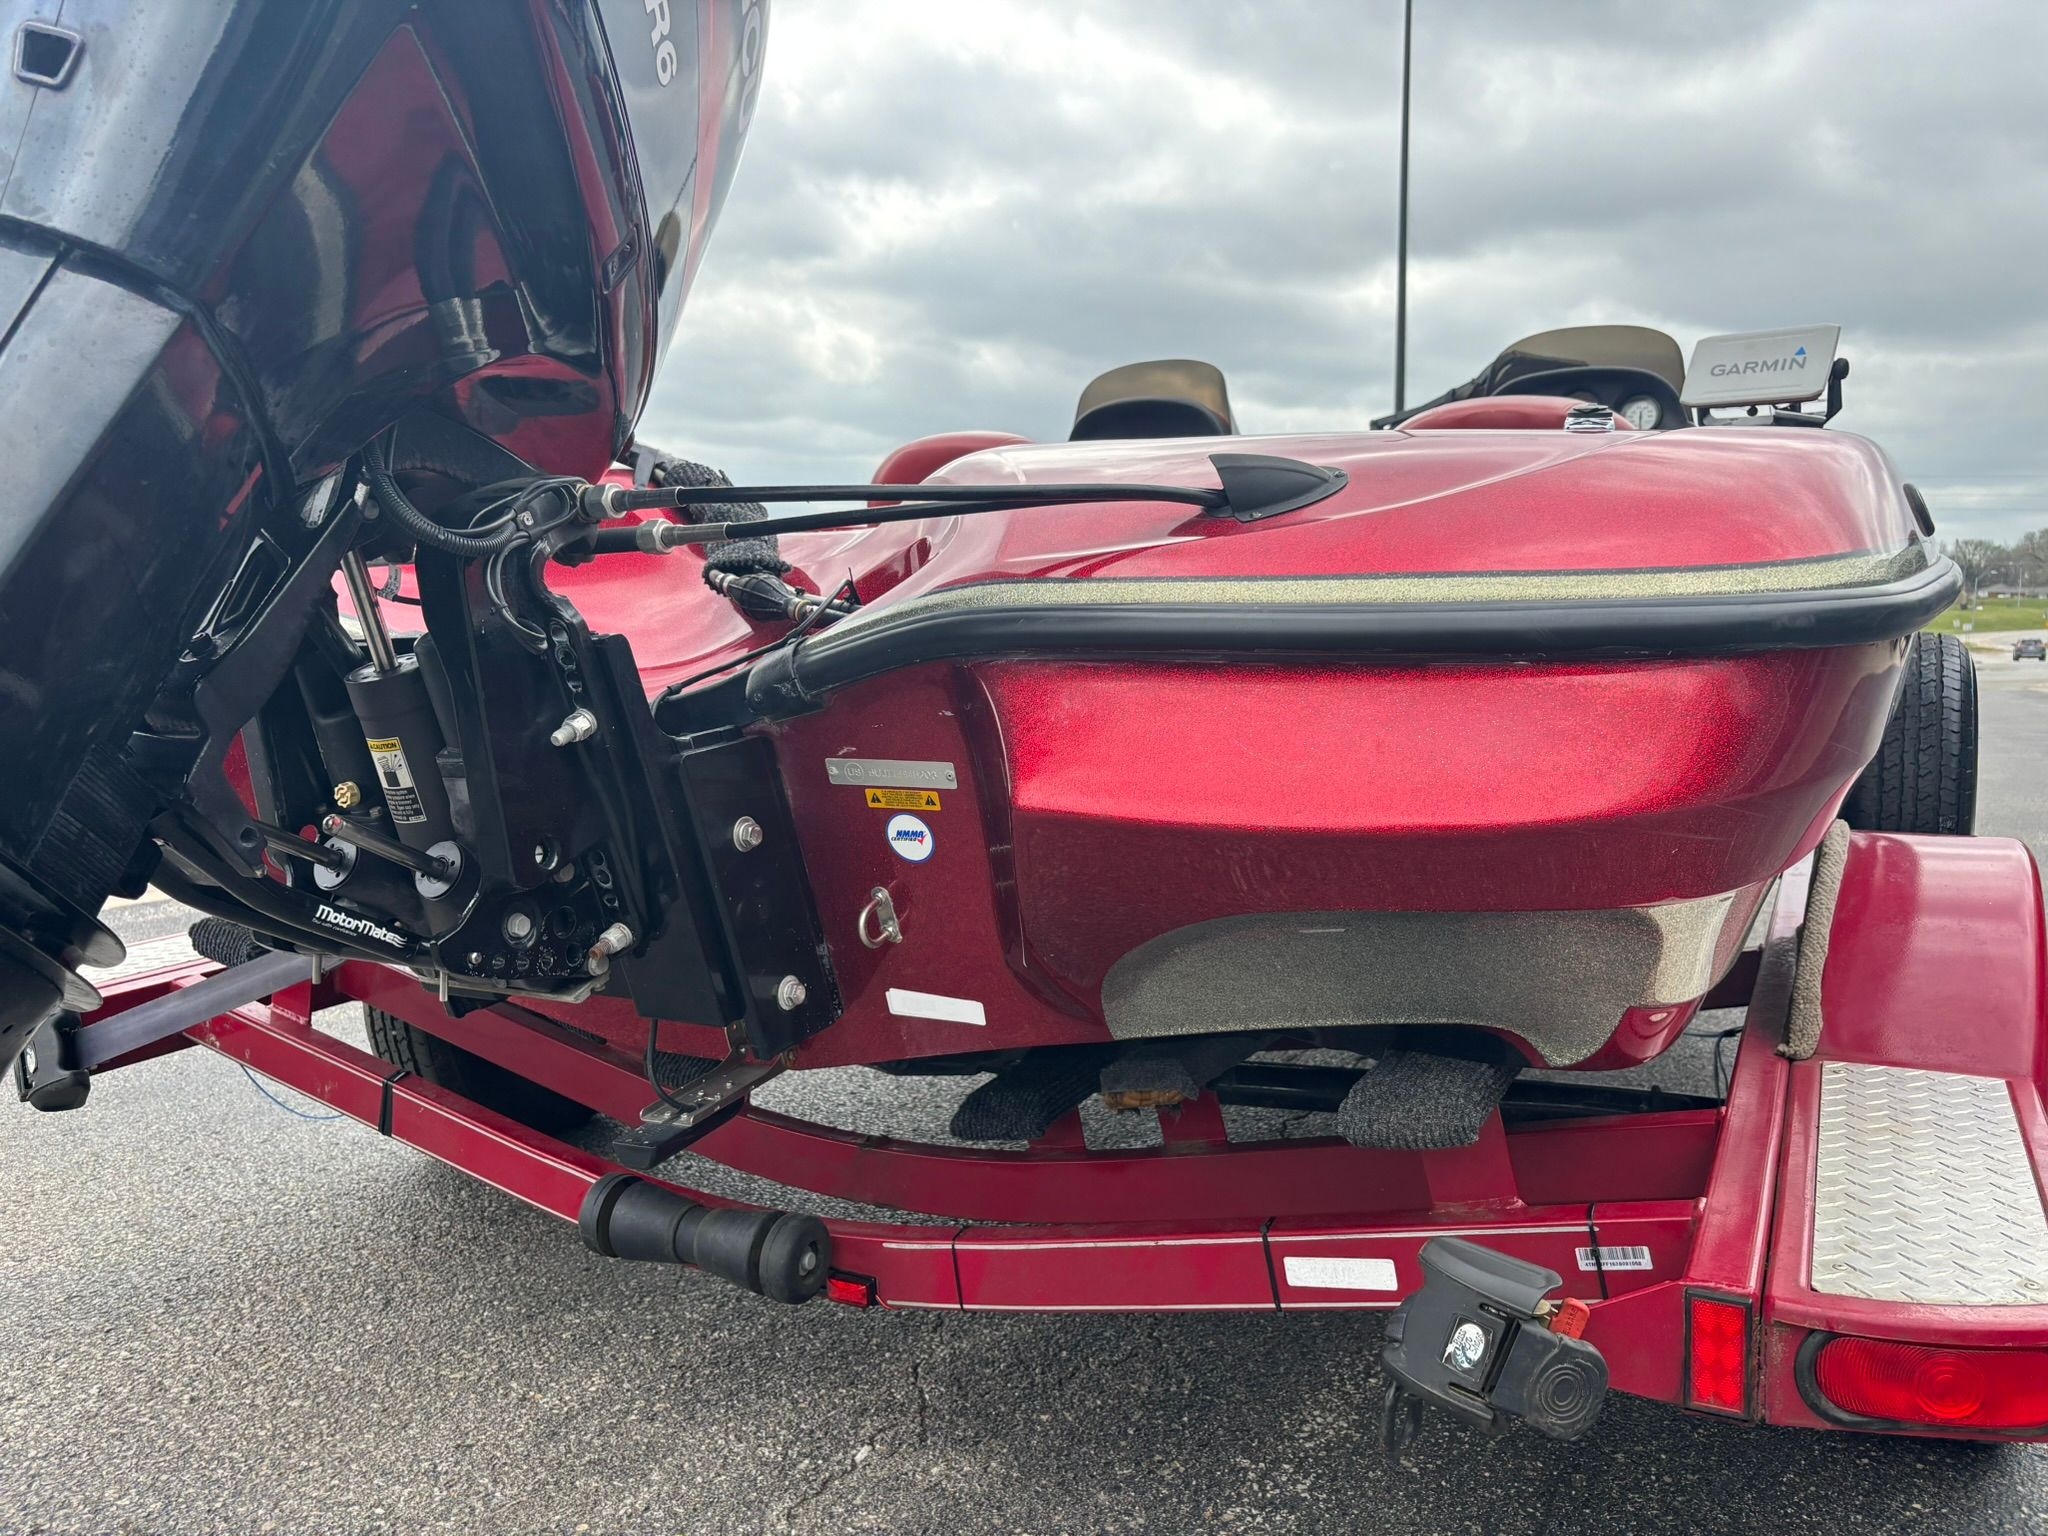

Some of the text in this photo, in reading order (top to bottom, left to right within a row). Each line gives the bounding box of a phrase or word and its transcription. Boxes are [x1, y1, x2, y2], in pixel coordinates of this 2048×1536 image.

[1710, 356, 1807, 377] GARMIN
[373, 742, 397, 750] CAUTION
[896, 830, 924, 838] NMMA
